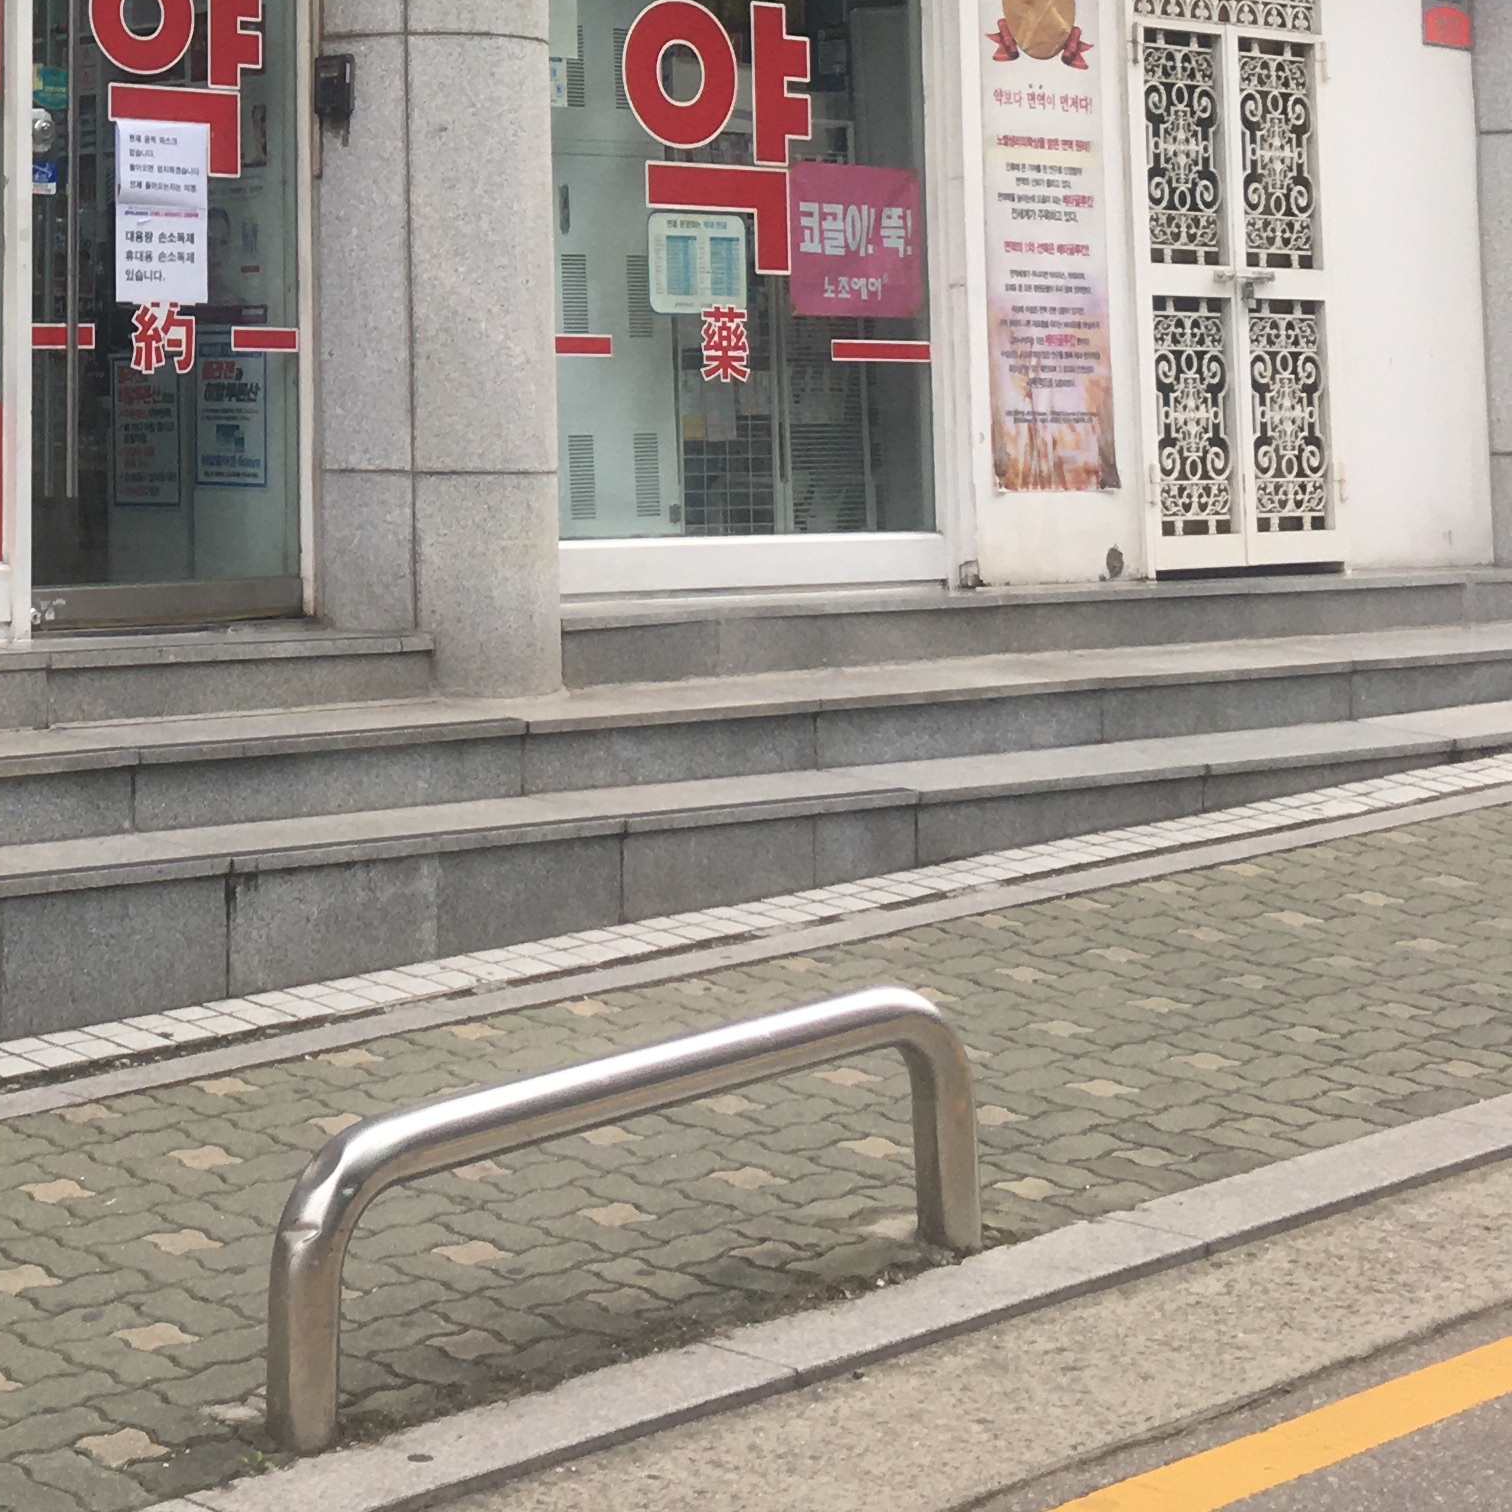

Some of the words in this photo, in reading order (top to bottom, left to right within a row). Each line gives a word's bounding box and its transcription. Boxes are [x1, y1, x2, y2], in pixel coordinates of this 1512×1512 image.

[993, 88, 1023, 107] 약보다
[125, 230, 153, 244] 대용량
[158, 231, 195, 245] 손소독제
[799, 201, 875, 257] 코골이!
[880, 207, 912, 258] 뚝!
[125, 249, 153, 263] 휴대용
[158, 250, 195, 264] 손소독제
[125, 268, 166, 282] 있습니다.
[699, 303, 750, 382] 藥
